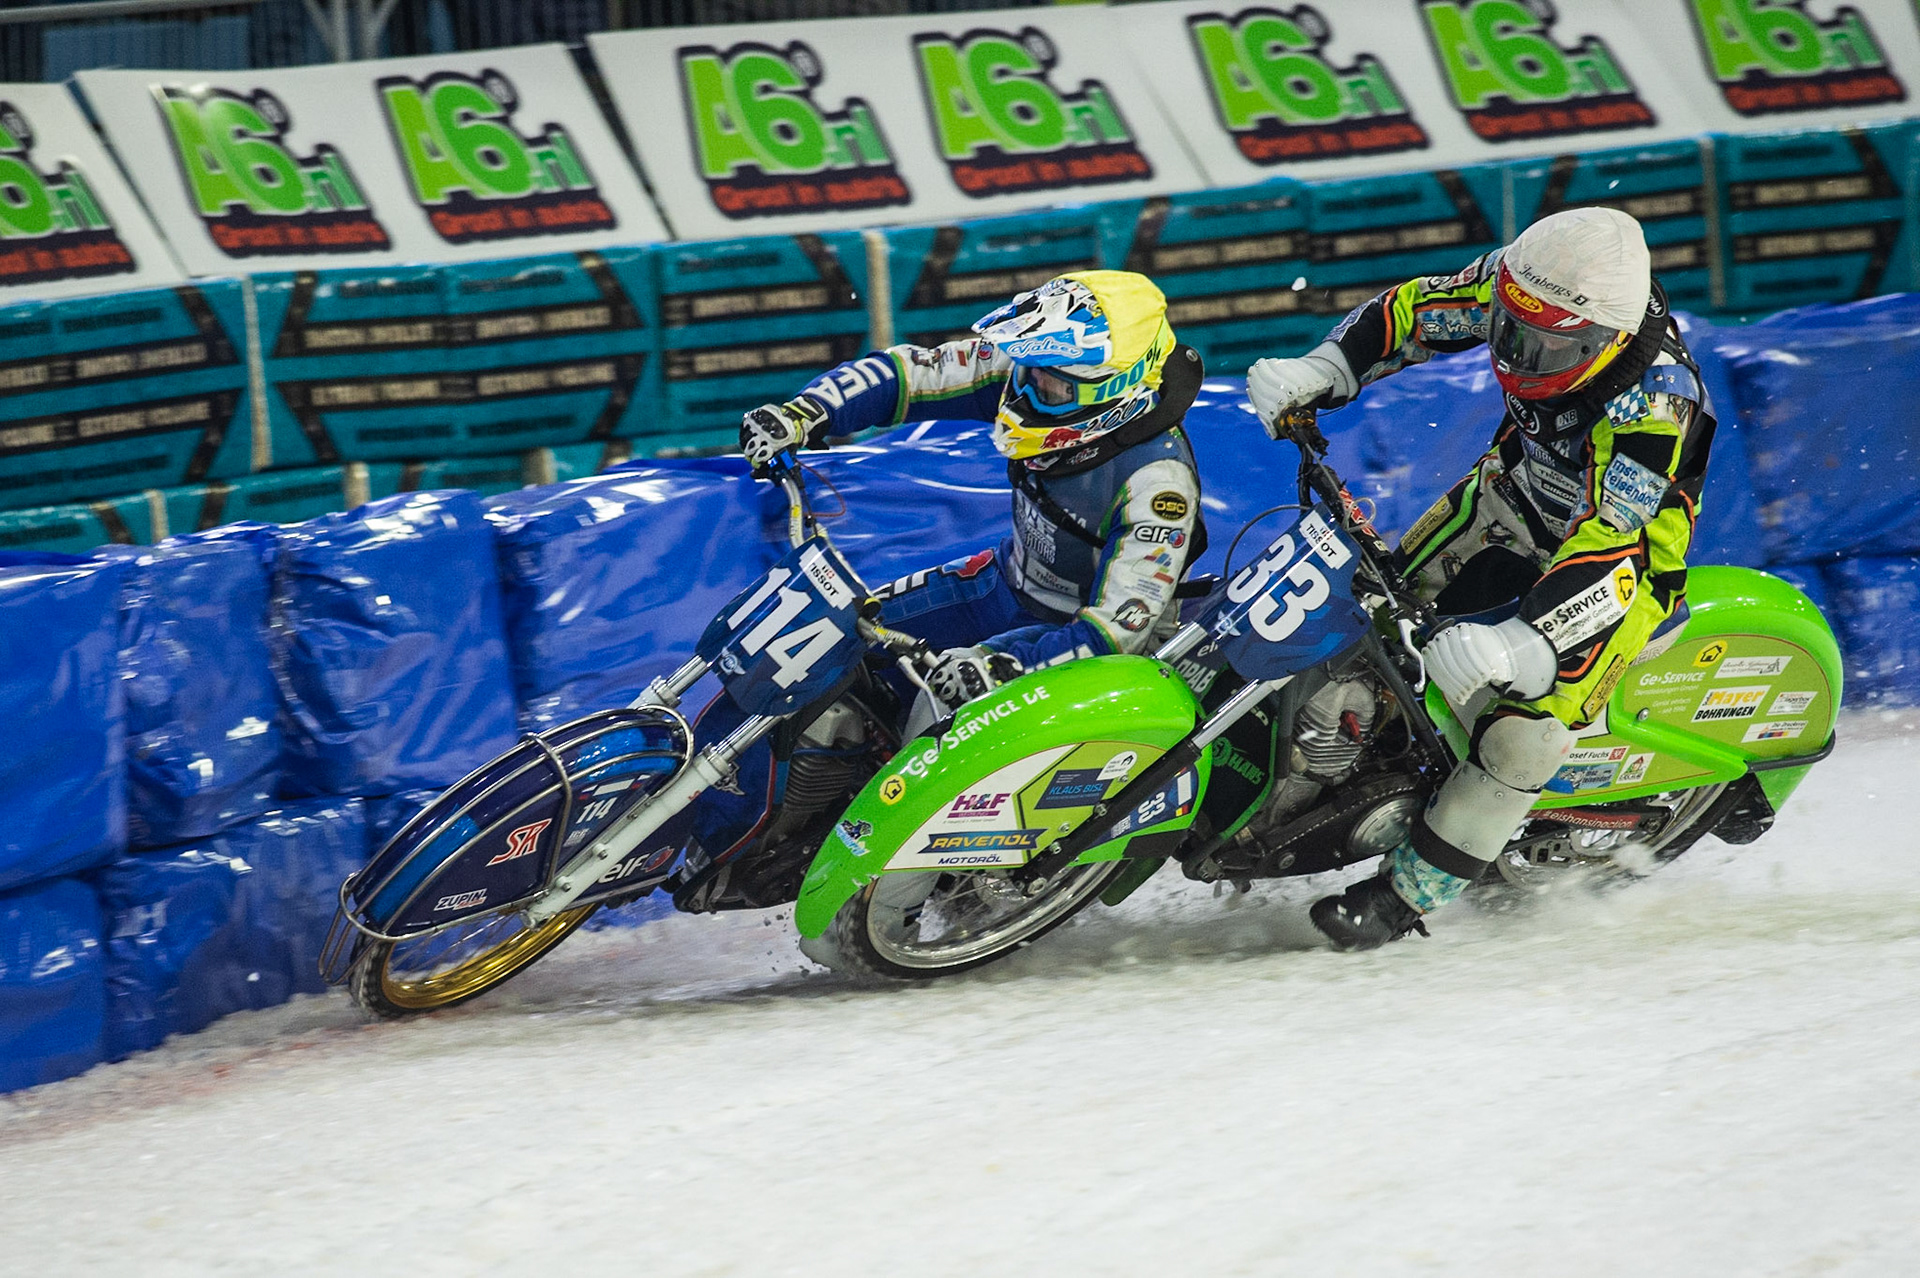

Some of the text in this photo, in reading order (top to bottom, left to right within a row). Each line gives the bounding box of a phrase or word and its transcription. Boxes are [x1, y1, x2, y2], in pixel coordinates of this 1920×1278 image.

[803, 357, 896, 410] UFA
[1304, 521, 1338, 560] TISSOT
[1226, 533, 1330, 643] 33
[727, 566, 846, 690] 114
[1709, 690, 1766, 707] Mayer
[942, 699, 1021, 750] SERVICE
[1694, 705, 1756, 721] BOHRUNGEN
[1568, 750, 1610, 761] osef Fuchs
[576, 797, 617, 825] 114
[950, 792, 1011, 812] H&F
[931, 833, 1032, 850] RAVENOL
[937, 853, 1003, 866] MOTORÖL
